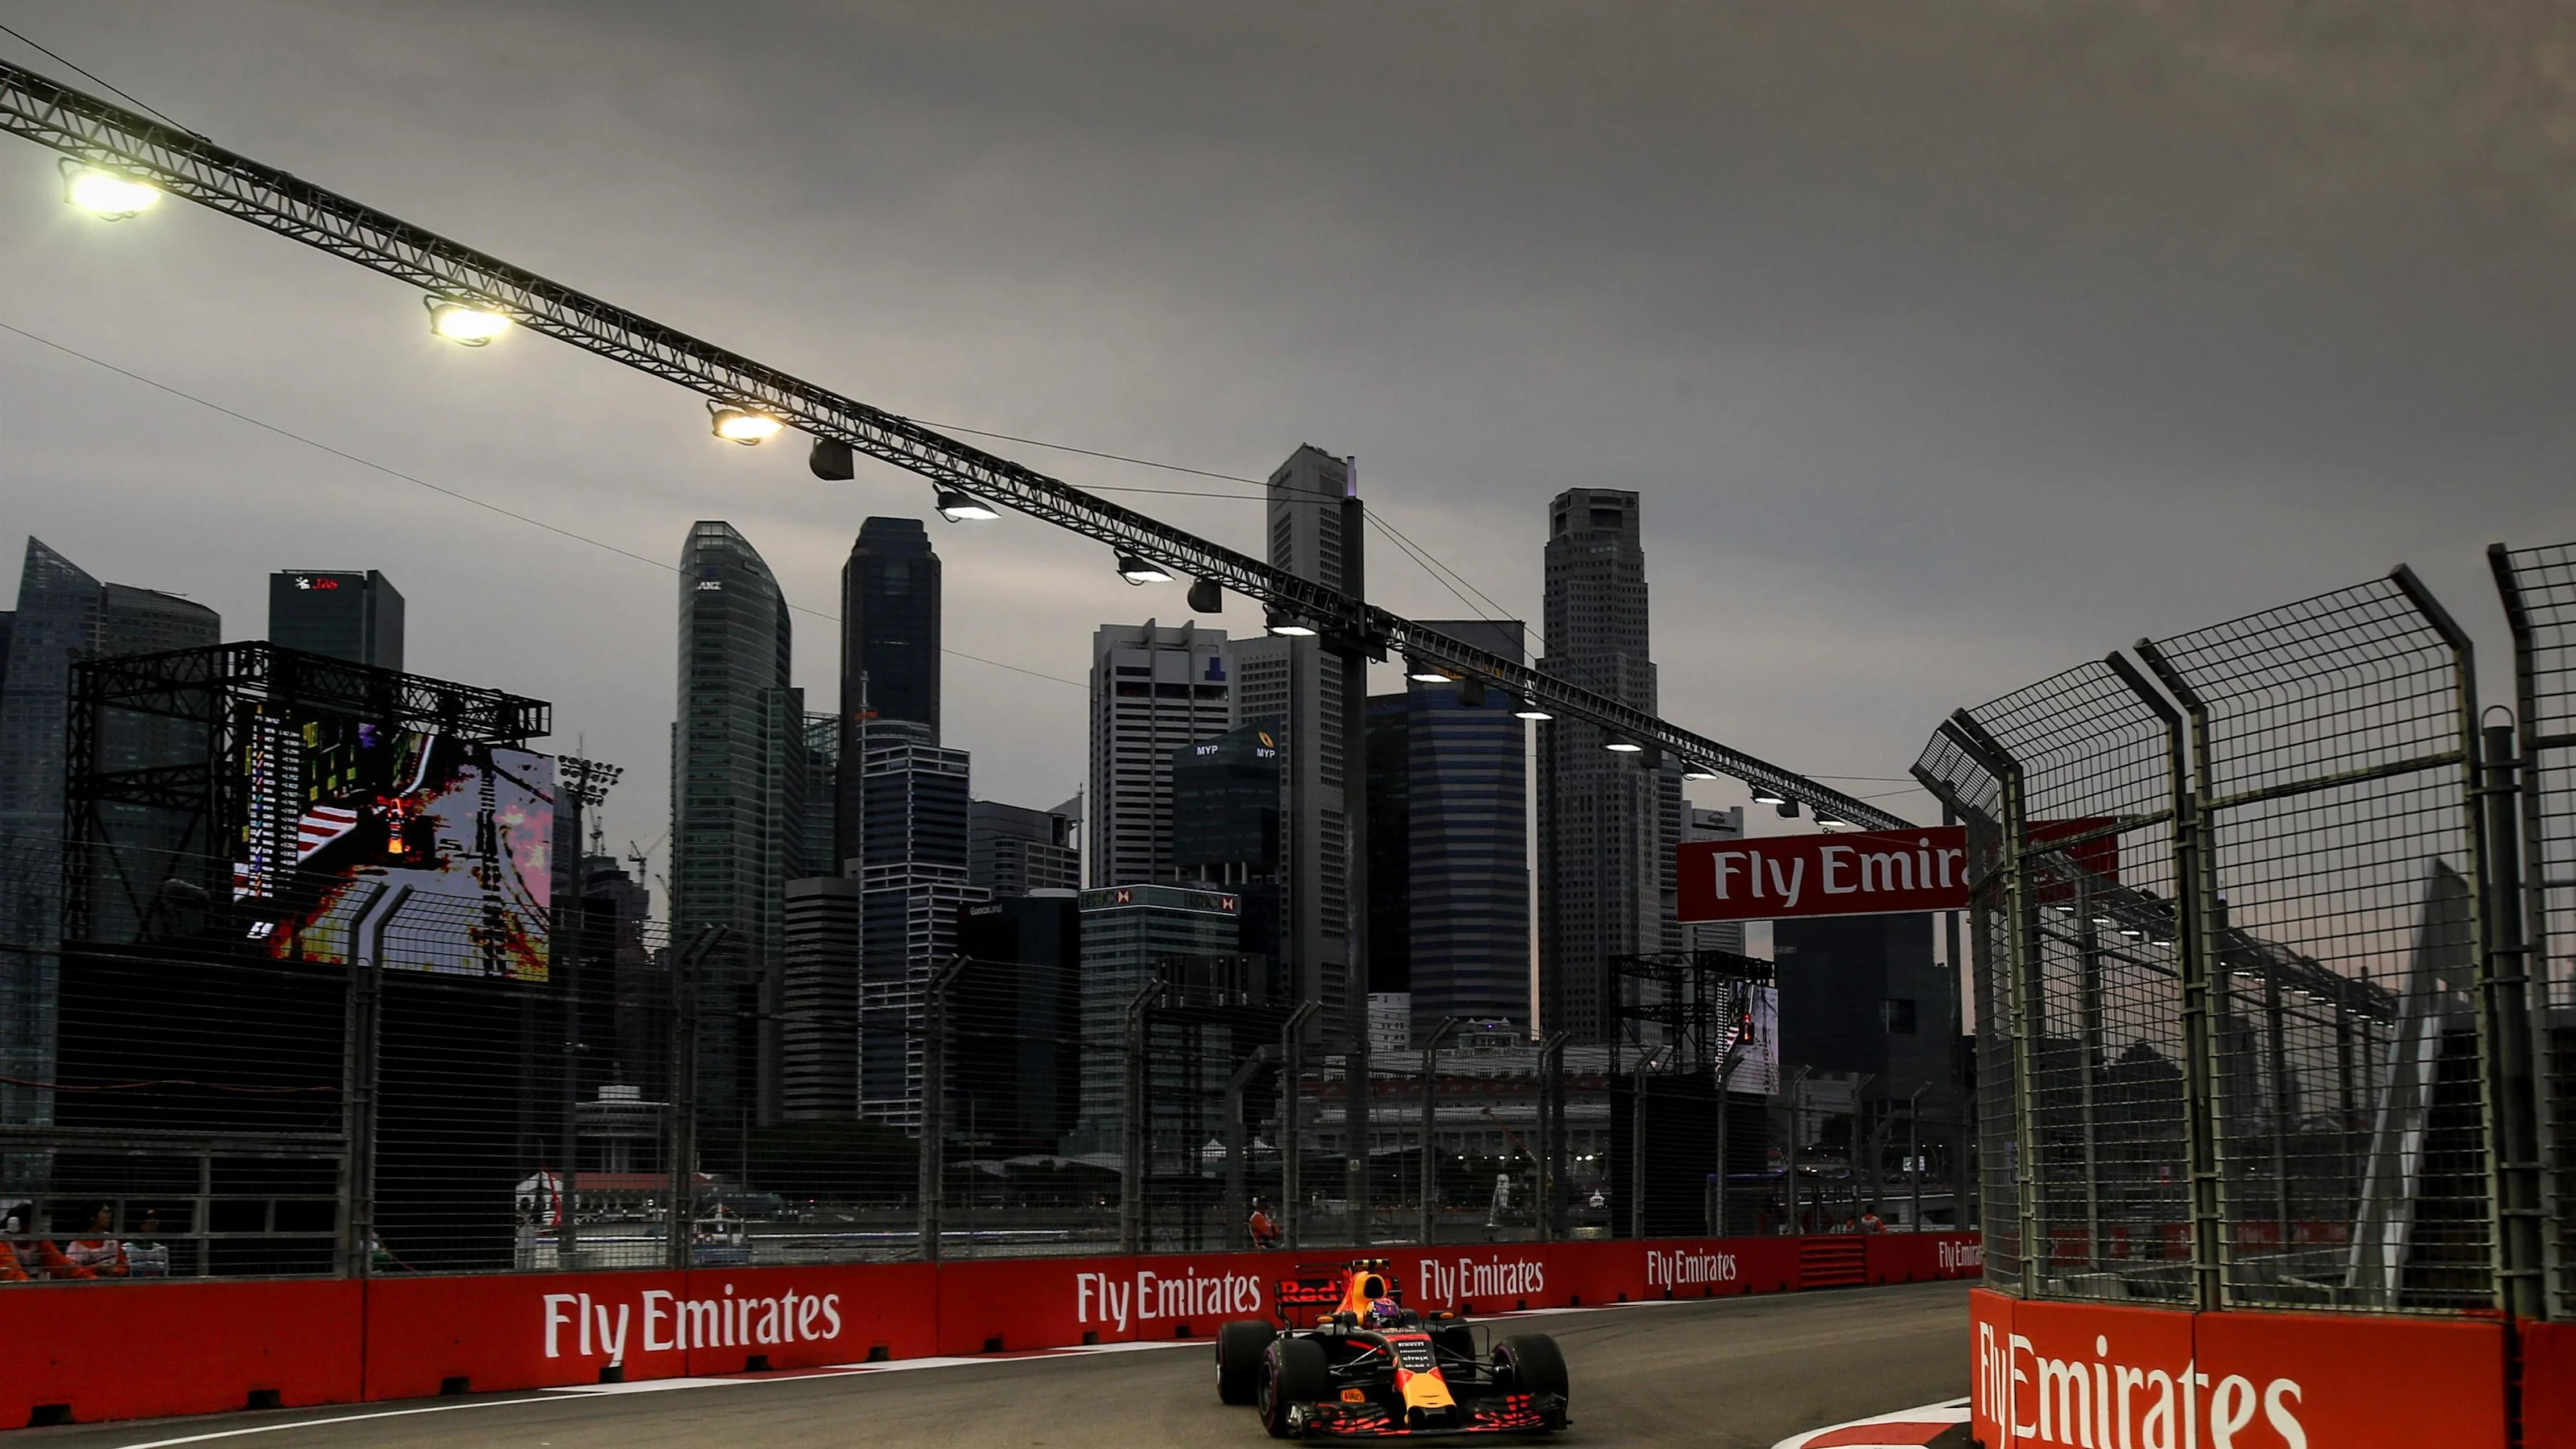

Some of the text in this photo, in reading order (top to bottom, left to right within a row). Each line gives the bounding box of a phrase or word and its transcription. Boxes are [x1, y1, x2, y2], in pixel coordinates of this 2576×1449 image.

[1196, 745, 1219, 756] MYP
[1257, 748, 1276, 758] MYP
[1711, 837, 1969, 907] Fly Emir
[1420, 1253, 1544, 1308] Fly Emirates
[1647, 1248, 1737, 1291] Fly Emirates
[1938, 1241, 1955, 1274] Fly
[543, 1283, 840, 1368] Fly Emirates
[1076, 1266, 1261, 1332] Fly Emirates
[1979, 1320, 2308, 1449] Fly Emirates
